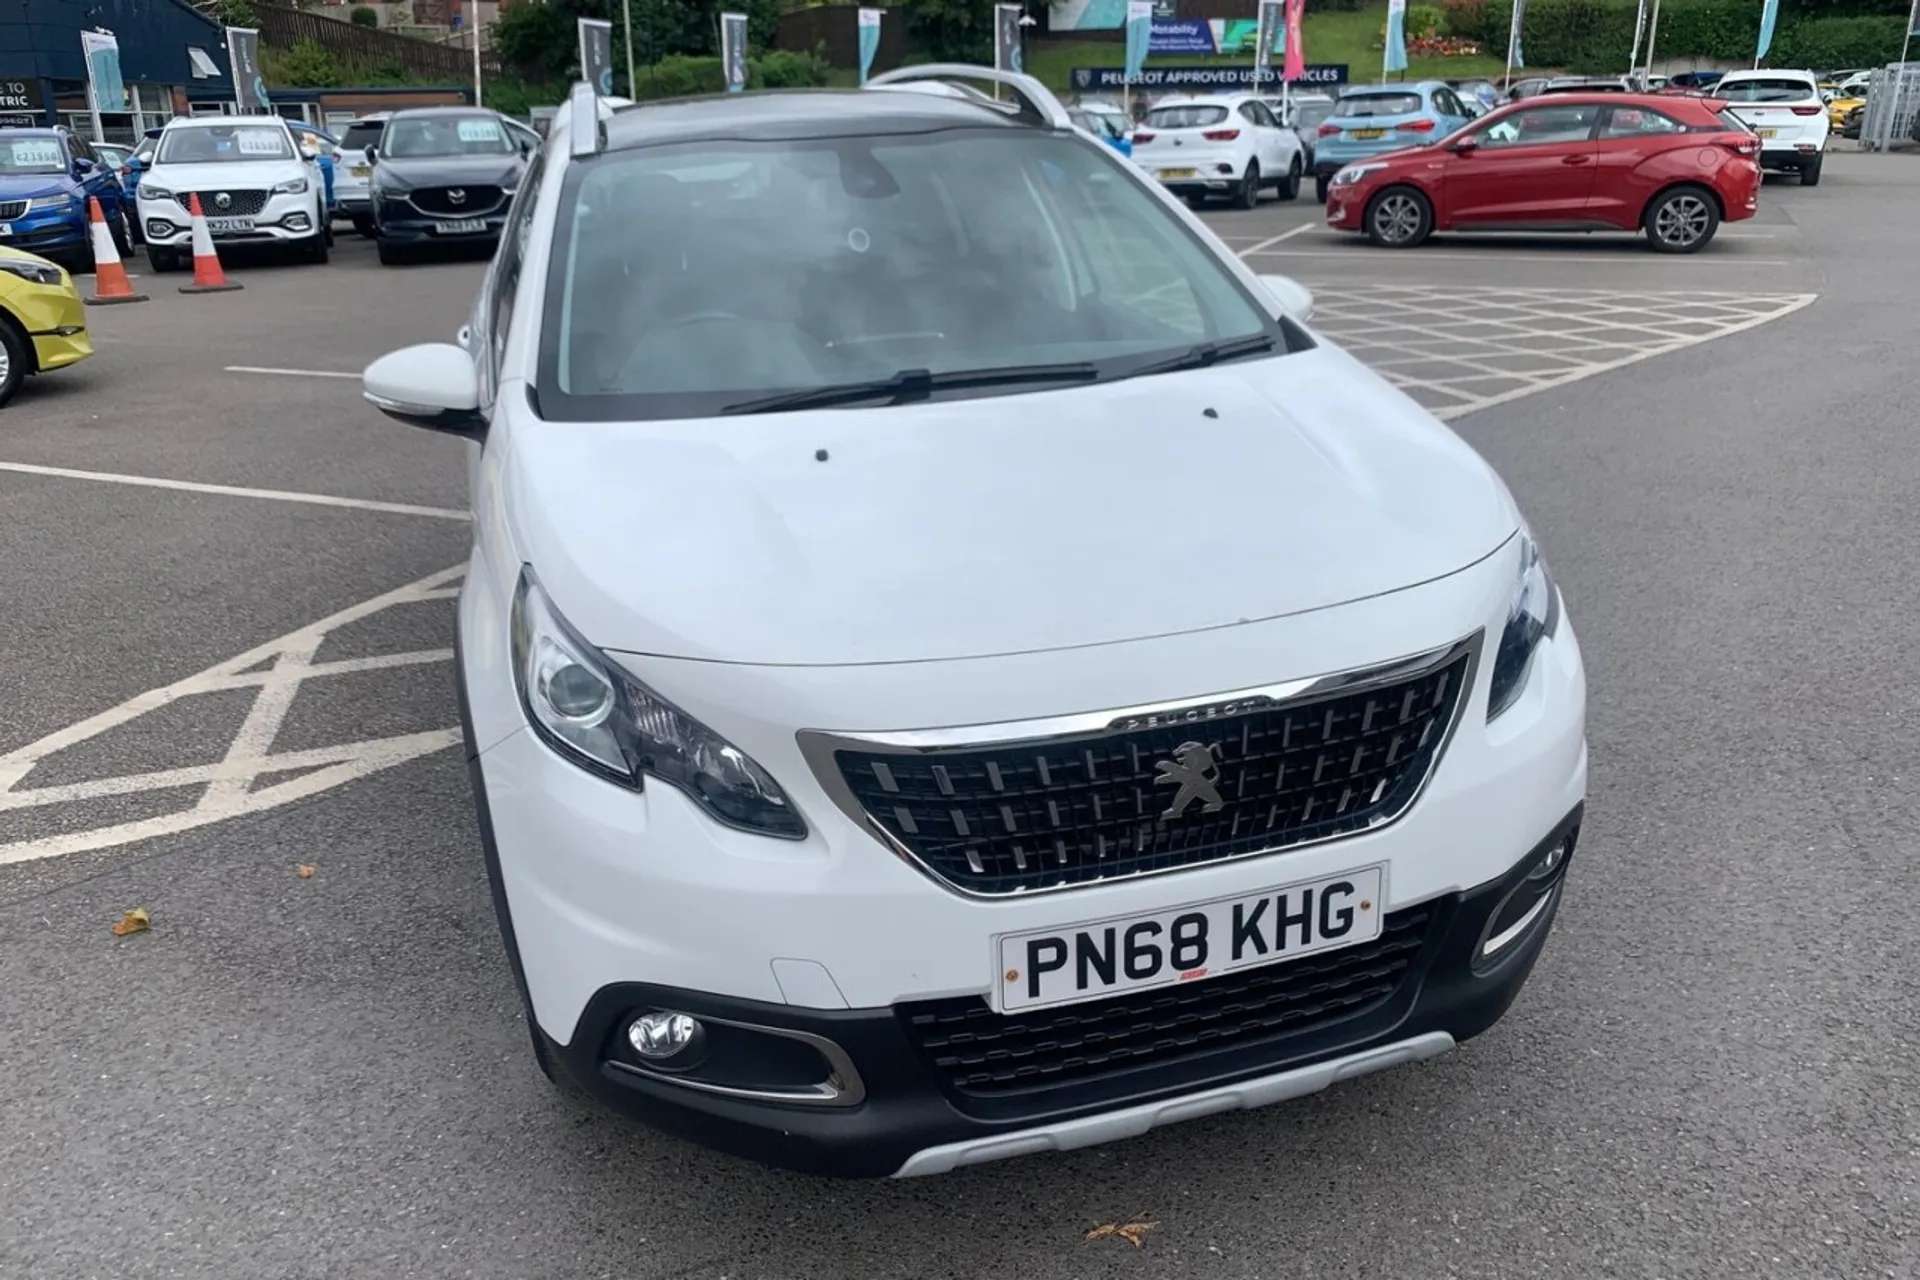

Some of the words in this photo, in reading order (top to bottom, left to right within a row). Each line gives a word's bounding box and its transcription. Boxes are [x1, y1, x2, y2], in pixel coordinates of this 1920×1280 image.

[1165, 71, 1237, 83] APPROVED
[6, 82, 25, 94] TO
[1127, 700, 1256, 730] PEUGEOT
[1027, 913, 1209, 999] PN68
[1231, 881, 1355, 960] KHG
